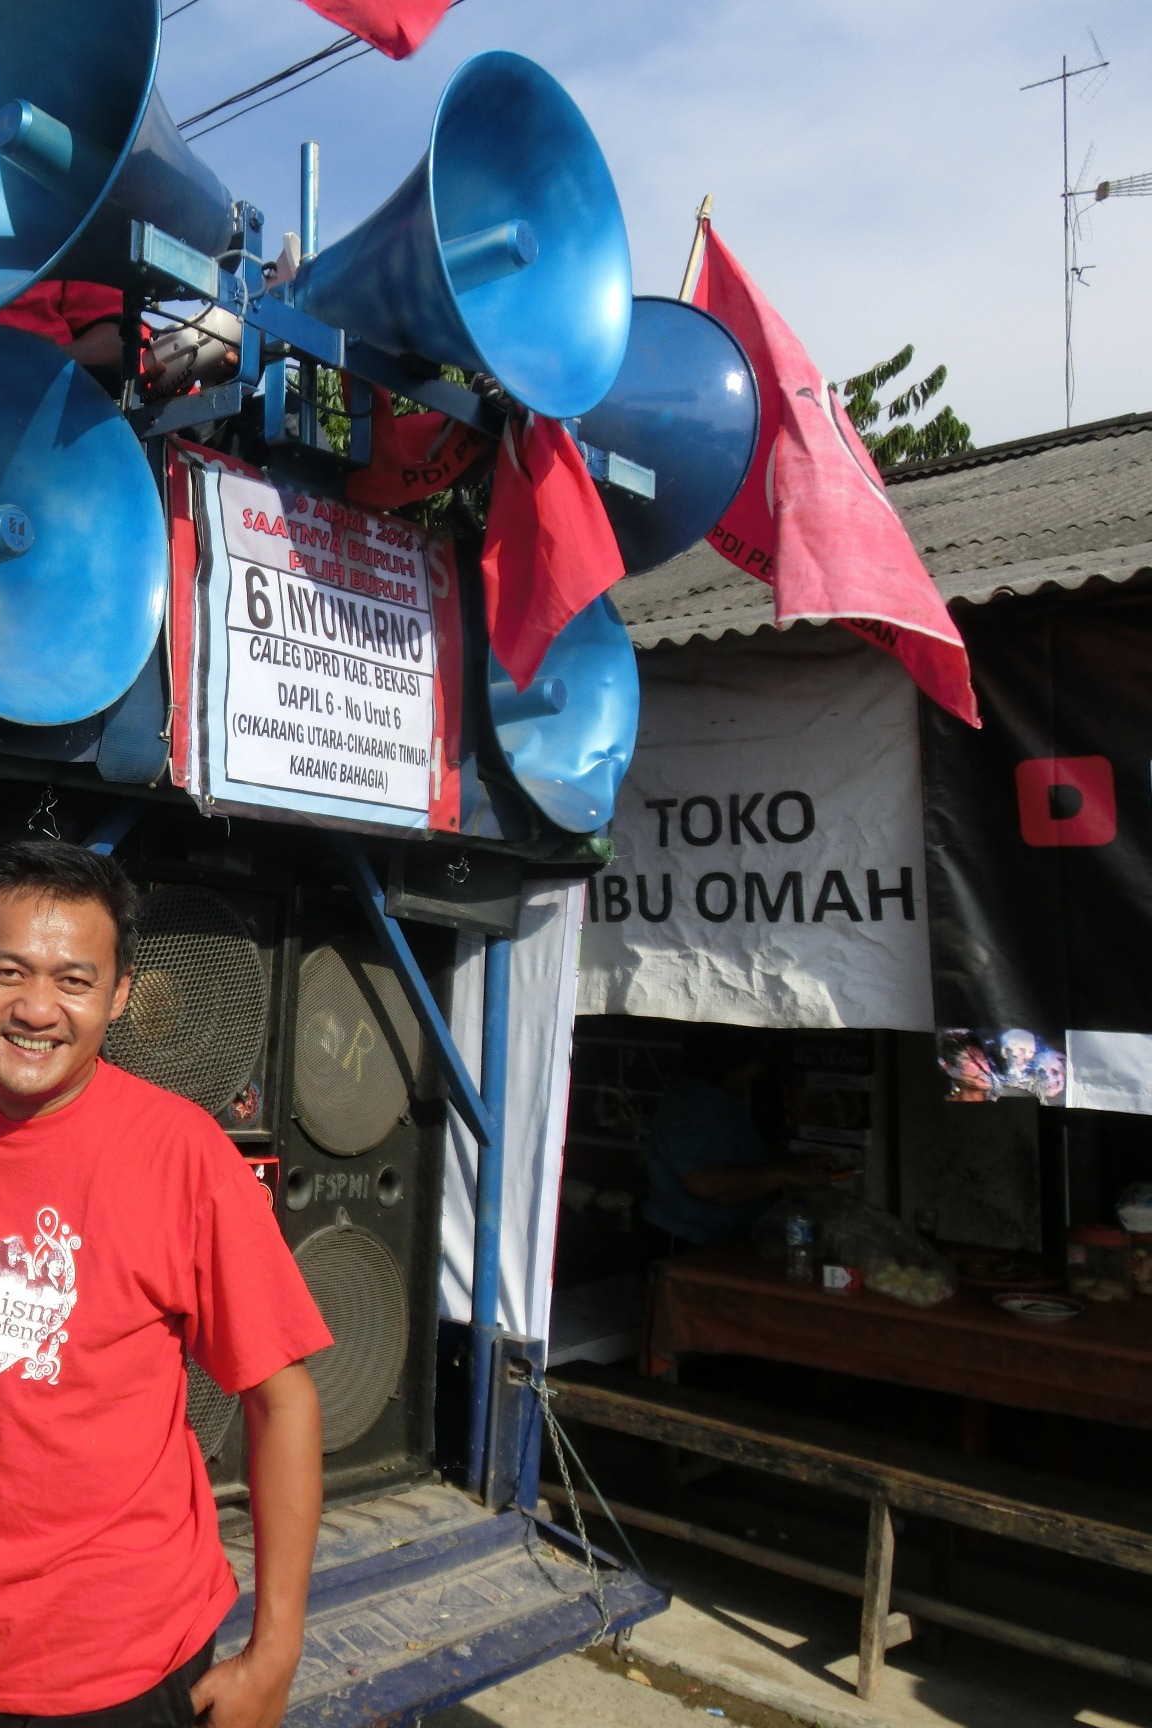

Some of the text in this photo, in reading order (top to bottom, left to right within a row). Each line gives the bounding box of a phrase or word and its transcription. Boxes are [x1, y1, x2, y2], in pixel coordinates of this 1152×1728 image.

[402, 461, 450, 487] PDI
[242, 508, 344, 556] SAATNYA
[347, 540, 416, 578] BURUH
[313, 499, 372, 538] APRIL
[377, 523, 415, 551] 2014
[712, 525, 745, 558] PDI
[288, 550, 345, 587] PILIH
[349, 567, 418, 606] BURUH
[244, 565, 424, 664] 6 NYUMARNO
[249, 635, 421, 698] CALEG DPRD KAB. BEKASI
[277, 681, 324, 715] DAPIL
[325, 691, 335, 716] 6
[344, 694, 362, 721] No
[364, 700, 392, 729] Urut
[393, 707, 402, 731] 6
[231, 711, 305, 745] (CIKARANG
[307, 724, 397, 763] UTARA-CIKARANG
[289, 755, 389, 794] KARANG BAHAGIA)
[645, 790, 817, 848] TOKO
[588, 866, 916, 924] IBU OMAH
[313, 1172, 372, 1202] FSPMI
